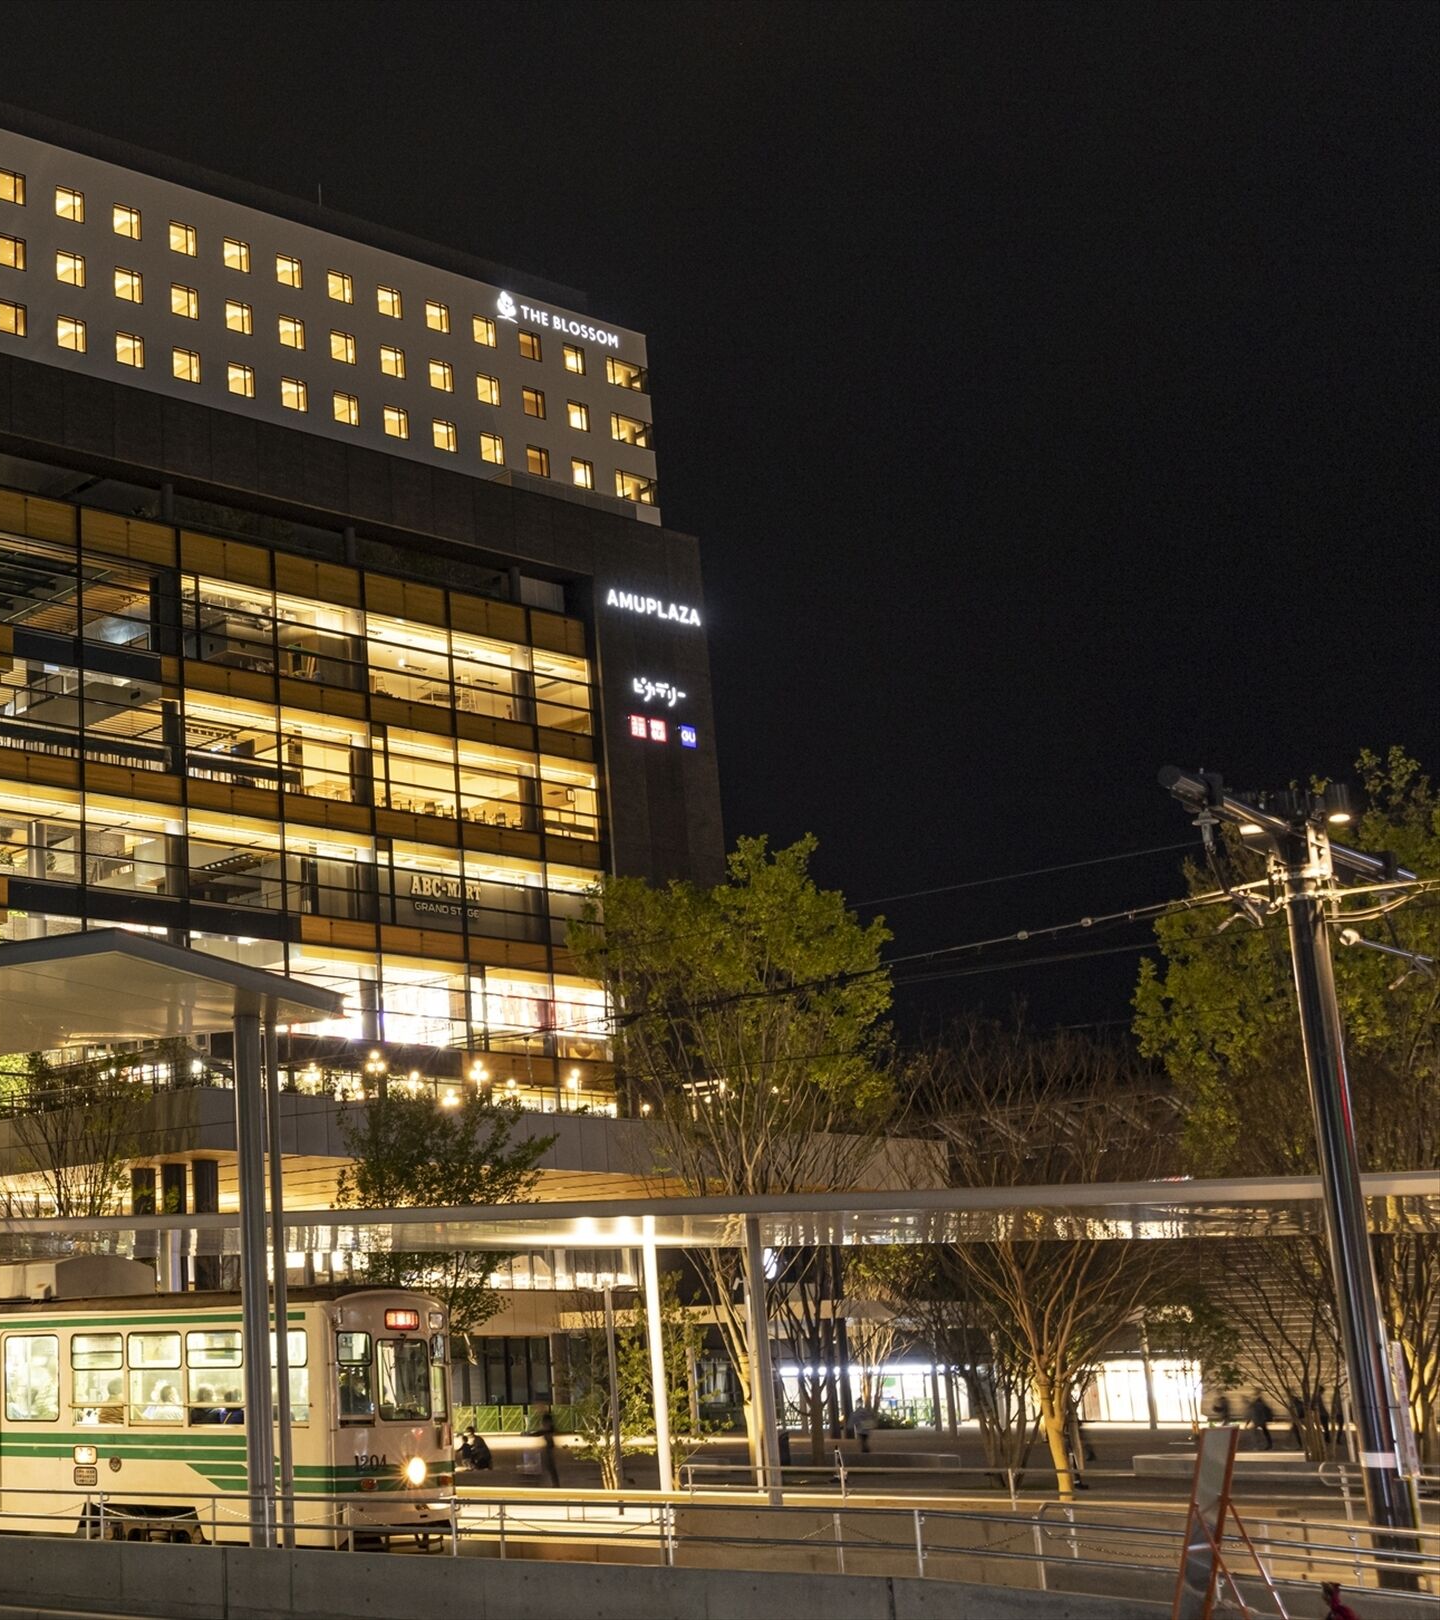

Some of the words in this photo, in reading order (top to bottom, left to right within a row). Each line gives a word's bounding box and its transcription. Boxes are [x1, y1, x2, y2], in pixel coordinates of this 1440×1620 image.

[520, 305, 549, 326] THE
[552, 315, 619, 349] BLOSSOM
[606, 588, 701, 627] AMUPLAZA
[633, 677, 686, 707] ピカデリー
[681, 730, 697, 743] GU
[414, 901, 449, 914] GRAND
[450, 906, 480, 918] STGE
[354, 1454, 387, 1471] 1204
